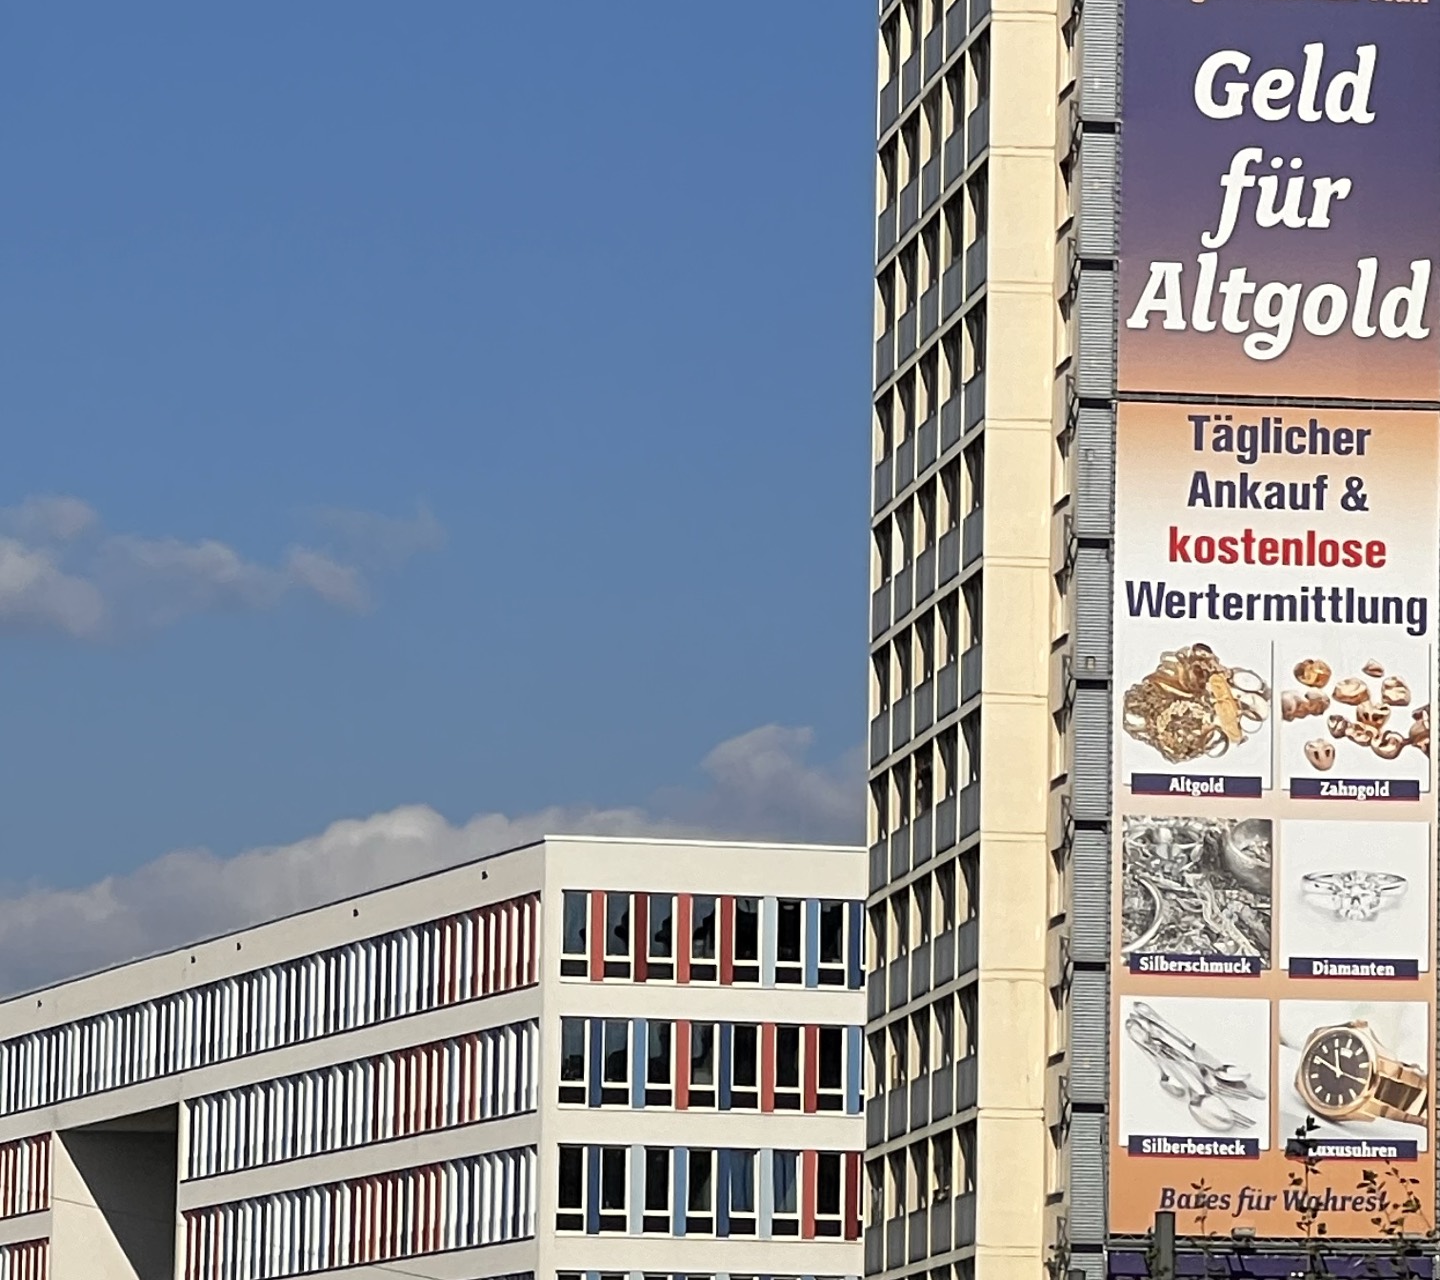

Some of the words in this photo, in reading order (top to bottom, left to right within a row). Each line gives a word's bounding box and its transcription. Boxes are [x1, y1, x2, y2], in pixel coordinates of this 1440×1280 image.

[1194, 42, 1377, 124] Geld
[1201, 147, 1353, 249] für
[1126, 252, 1431, 361] Altgold
[1188, 415, 1372, 464] Täglicher
[1187, 471, 1328, 510] Ankauf
[1340, 476, 1369, 511] &
[1169, 526, 1387, 568] kostenlose
[1125, 581, 1428, 636] Wertermittlung
[1169, 777, 1225, 796] Altgold
[1320, 781, 1390, 801] Zahngold
[1139, 956, 1252, 975] Silberschmuck
[1312, 960, 1395, 976] Diamanten
[1142, 1139, 1246, 1156] Silberbesteck
[1160, 1187, 1231, 1211] Bares
[1231, 1186, 1278, 1218] für
